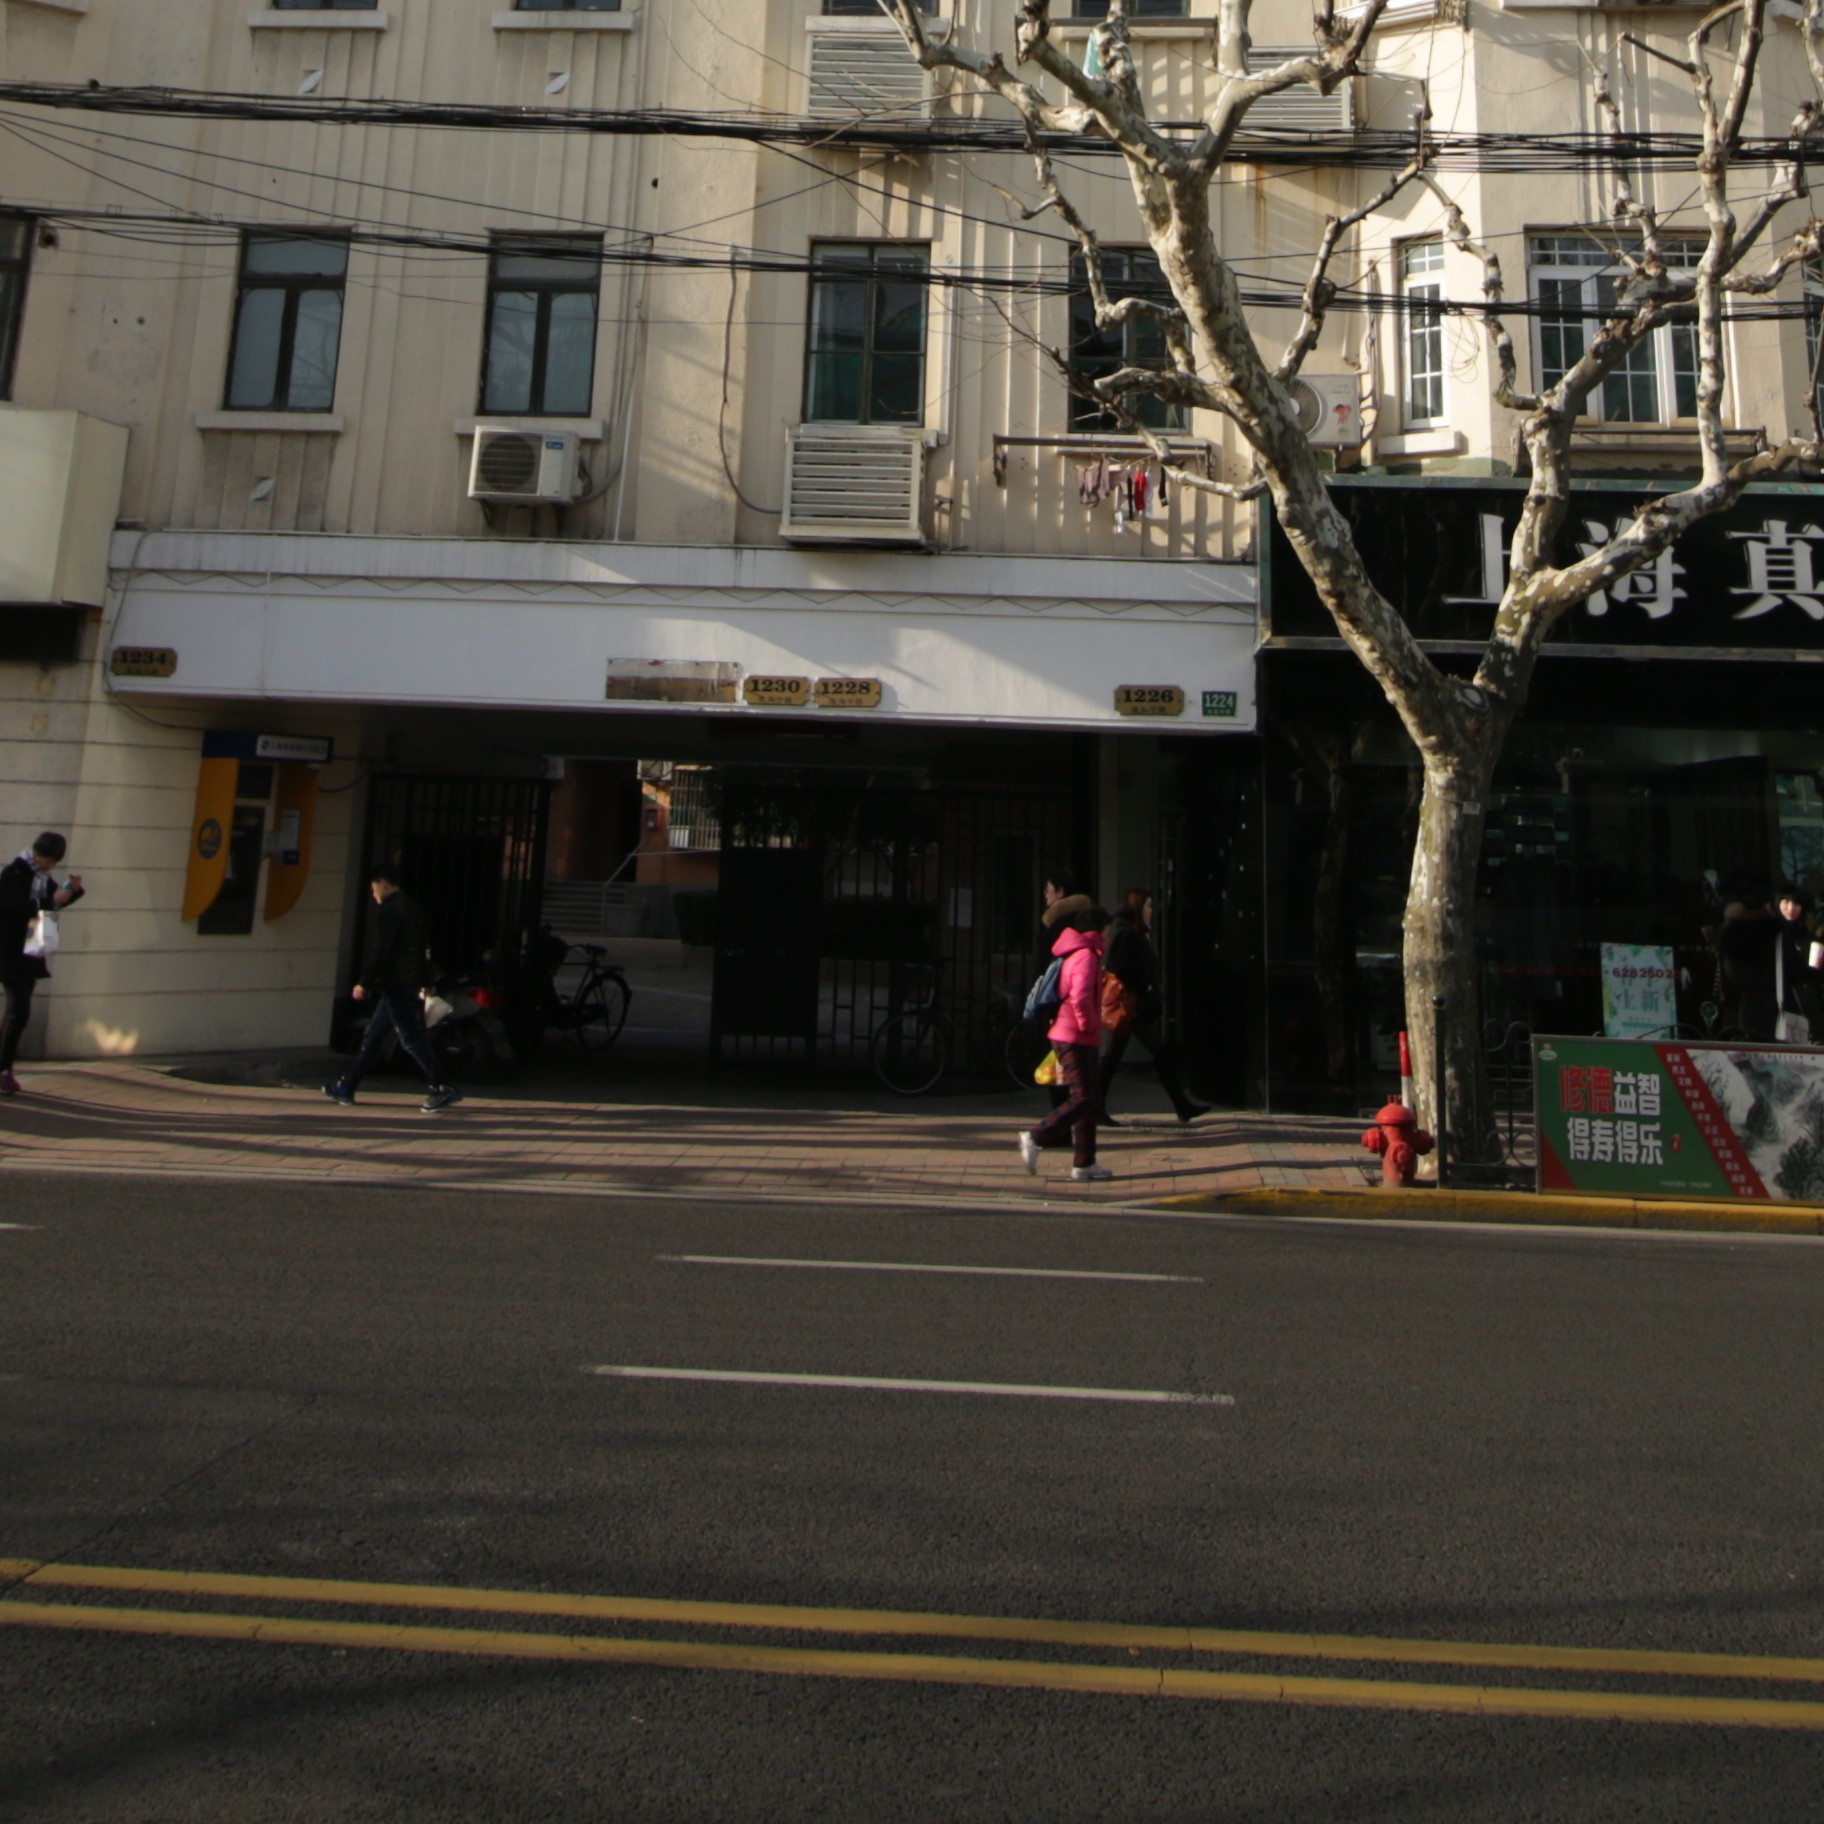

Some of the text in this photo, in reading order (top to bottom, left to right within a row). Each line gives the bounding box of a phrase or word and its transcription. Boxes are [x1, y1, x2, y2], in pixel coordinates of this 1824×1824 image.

[120, 650, 167, 664] 1234
[751, 679, 800, 693] 1230
[821, 681, 871, 695] 1228
[1123, 688, 1174, 703] 1226
[1204, 693, 1234, 708] 1224
[1558, 1064, 1661, 1116] 修德益智
[1566, 1117, 1664, 1166] 得寿得乐
